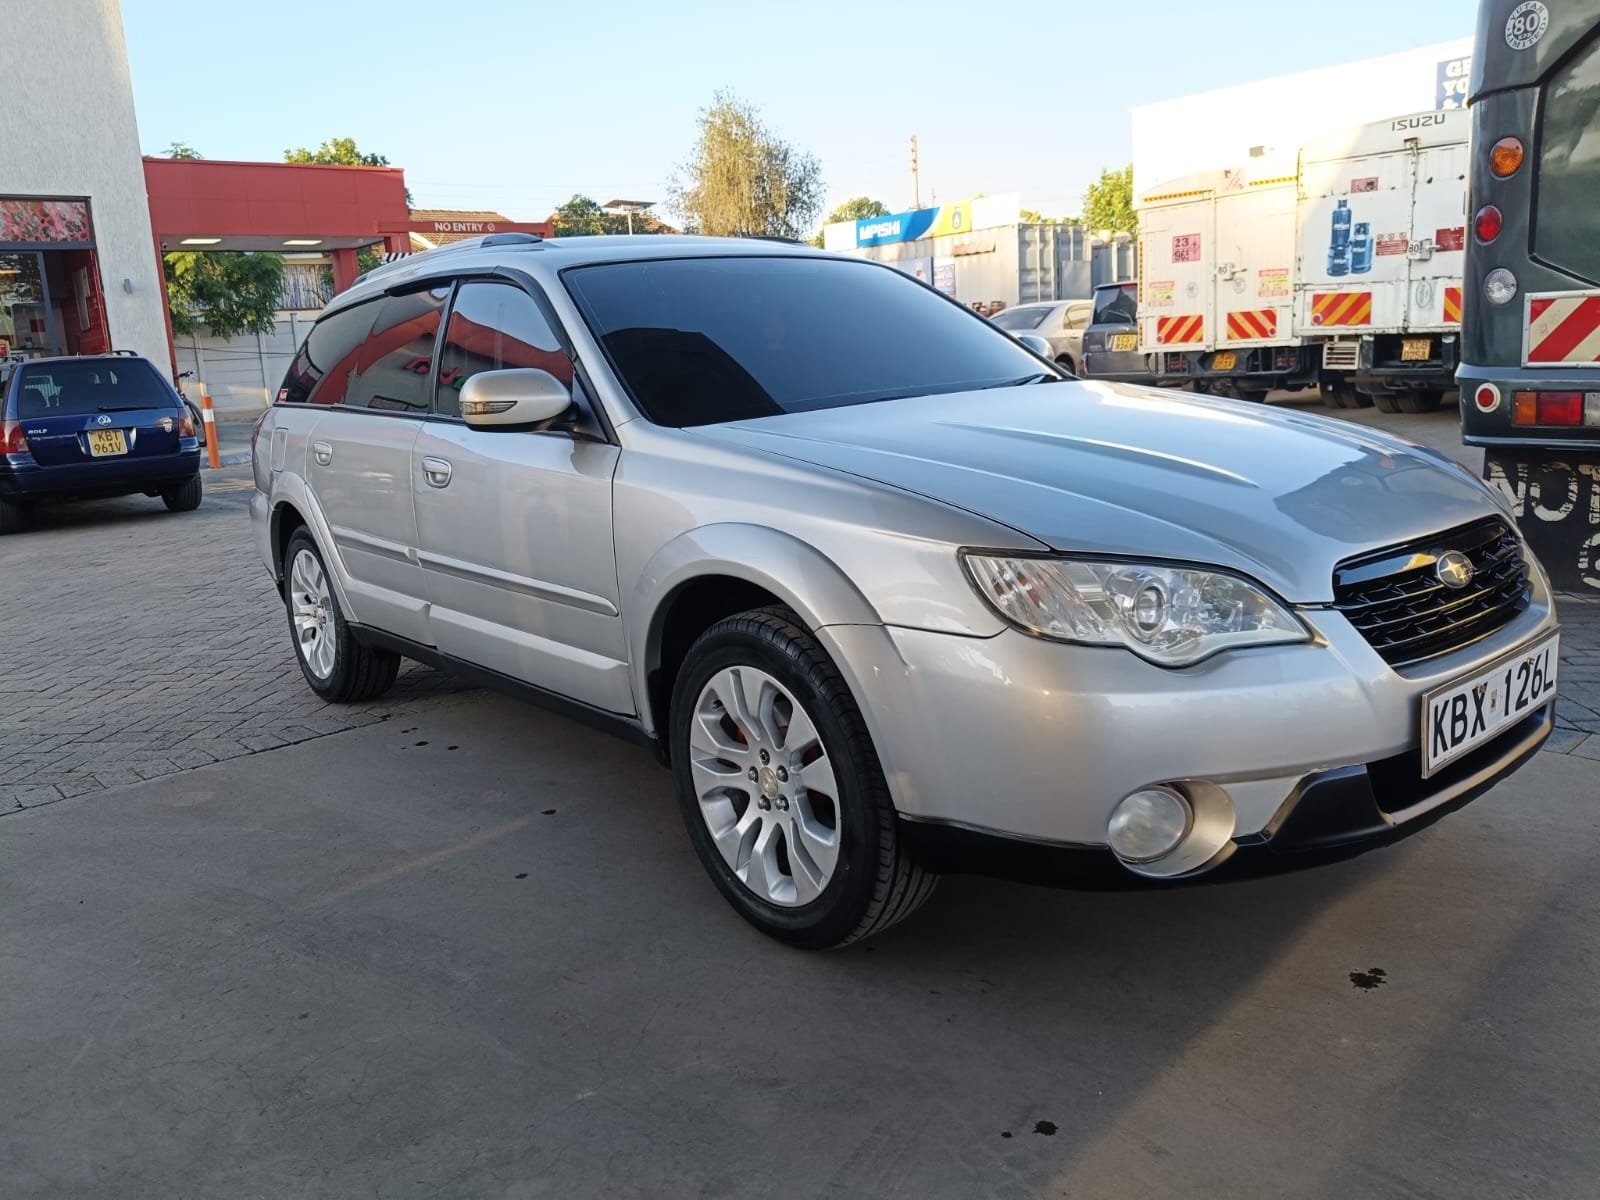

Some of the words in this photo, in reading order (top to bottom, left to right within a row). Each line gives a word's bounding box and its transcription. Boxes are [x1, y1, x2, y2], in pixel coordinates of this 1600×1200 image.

[1513, 13, 1539, 35] 80
[1391, 113, 1446, 131] ISUZU
[434, 222, 451, 232] NO
[453, 222, 484, 232] ENTRY
[859, 220, 901, 240] MPISHI
[1175, 237, 1189, 248] 23
[97, 430, 119, 442] KBT
[94, 442, 122, 454] 961V
[1433, 681, 1488, 758] KBX
[1504, 648, 1553, 717] 126L
